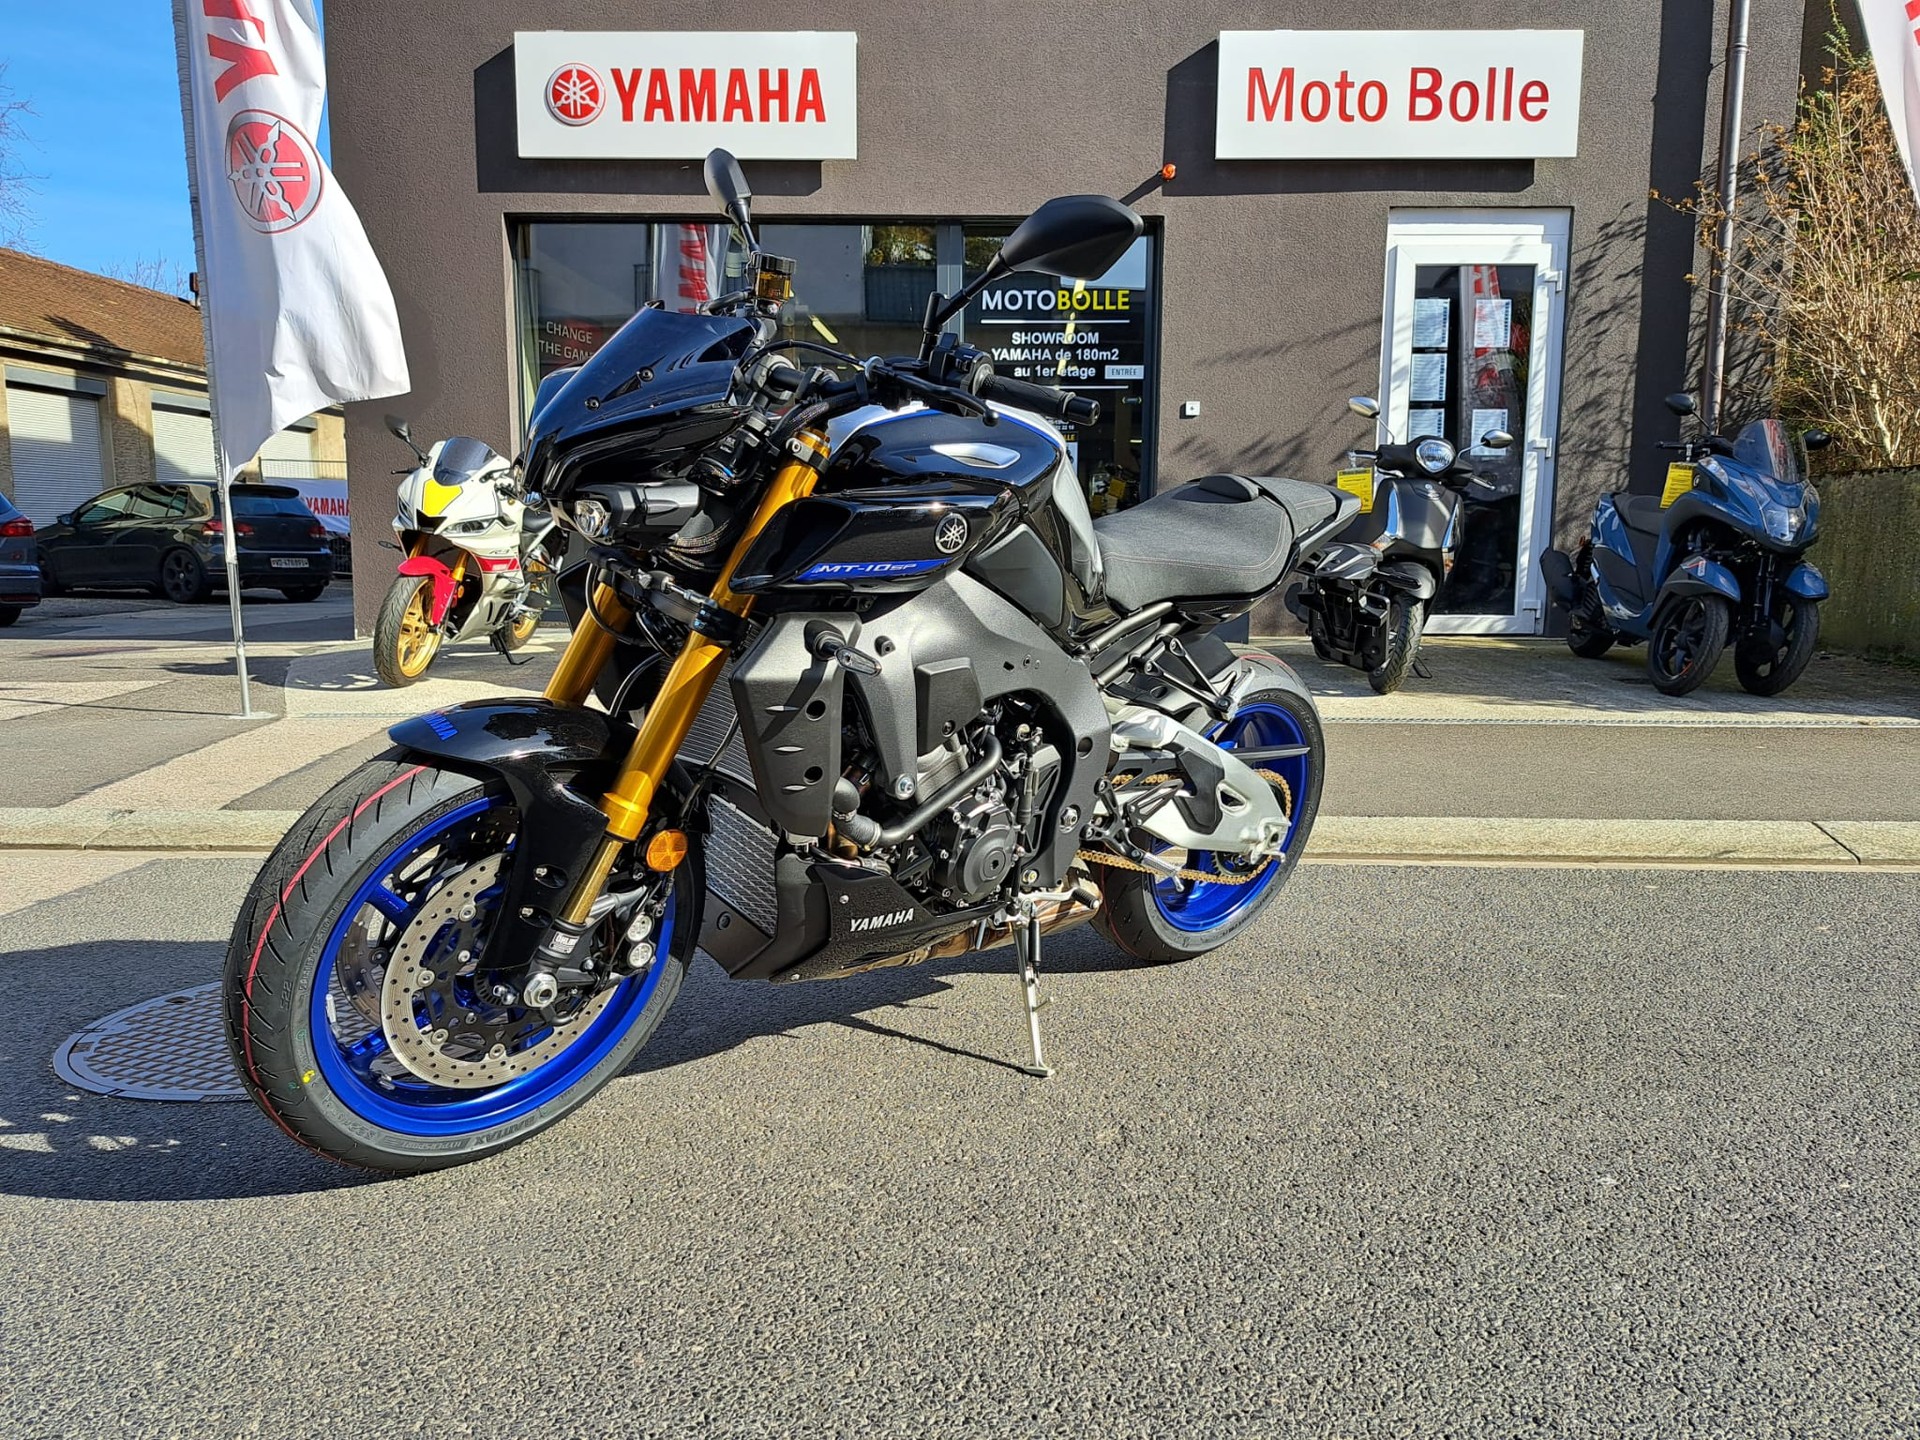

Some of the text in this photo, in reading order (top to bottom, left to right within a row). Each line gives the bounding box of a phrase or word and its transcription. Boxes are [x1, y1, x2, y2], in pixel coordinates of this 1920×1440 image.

[610, 68, 827, 123] YAMAHA
[1246, 67, 1550, 123] Moto Bolle
[546, 321, 593, 345] CHANGE
[1011, 332, 1100, 345] SHOWROOM
[538, 339, 562, 357] THE
[991, 348, 1120, 361] YAMAHA de 180m2
[1014, 366, 1031, 377] au
[1035, 365, 1057, 377] 1er
[850, 907, 915, 932] YAMAHA
